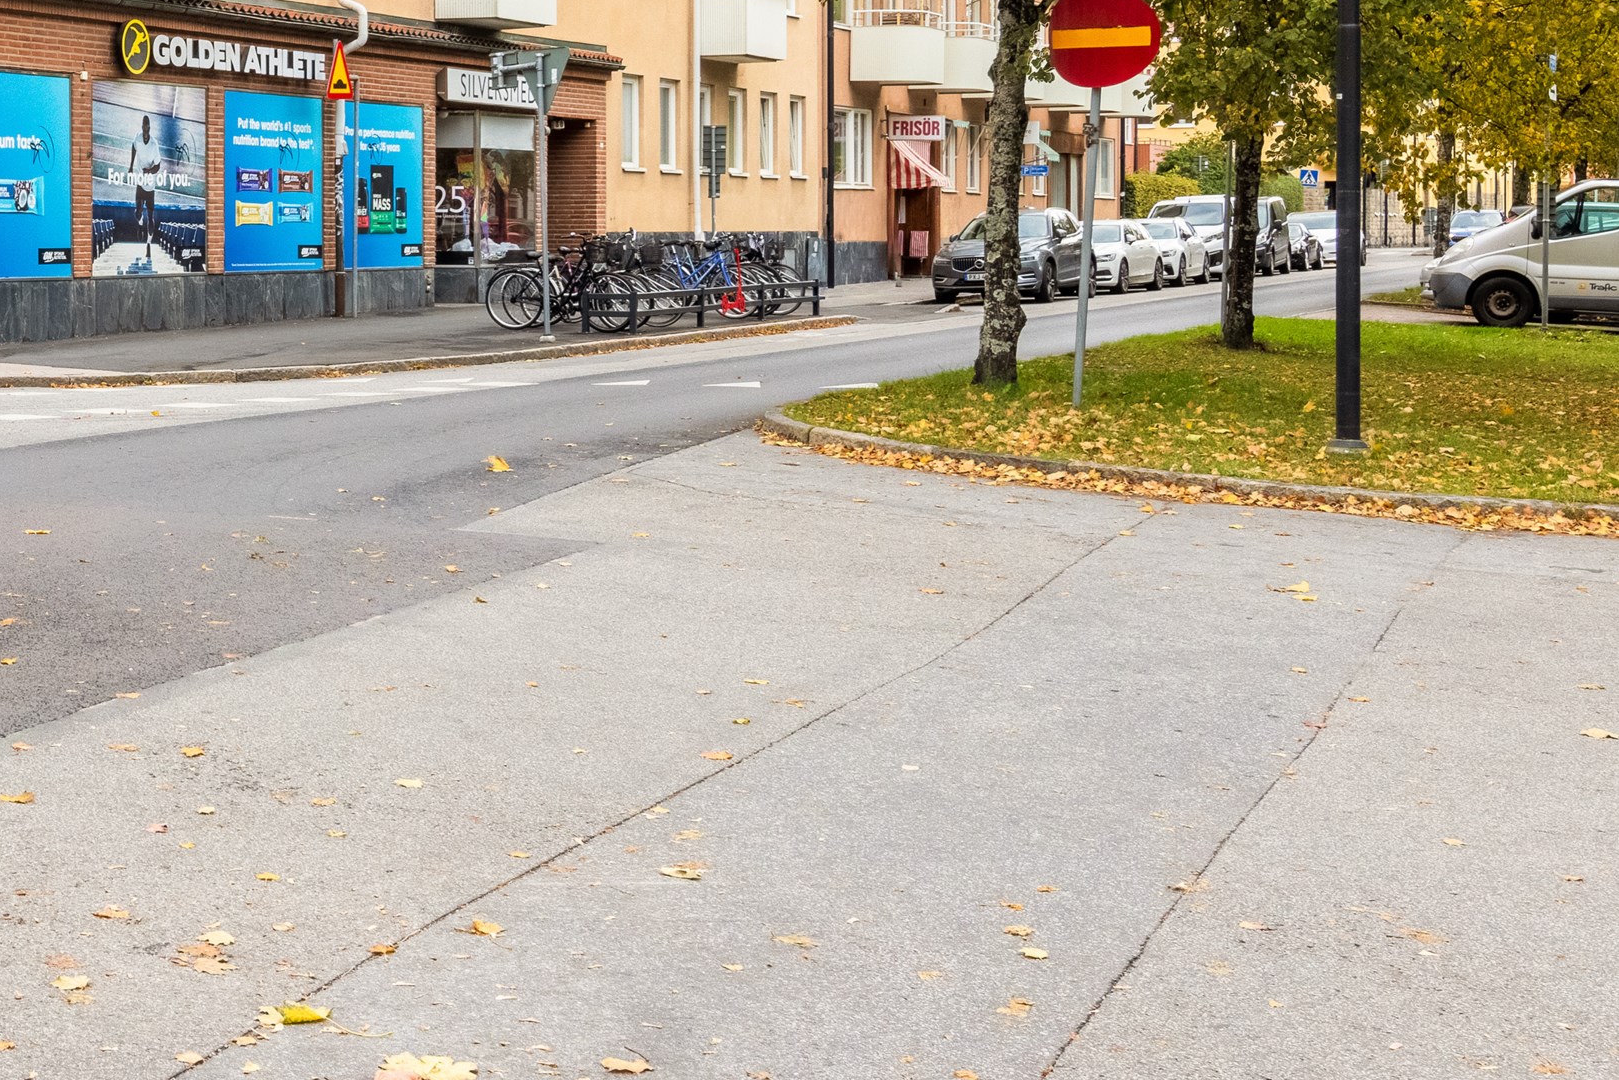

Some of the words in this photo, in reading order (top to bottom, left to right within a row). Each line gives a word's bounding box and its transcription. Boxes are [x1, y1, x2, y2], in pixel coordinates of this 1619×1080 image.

[152, 34, 241, 73] GOLDEN
[244, 45, 326, 81] ATHLETE
[249, 118, 260, 130] the
[892, 117, 940, 137] FRISÖR
[16, 134, 43, 150] taste
[108, 168, 124, 185] For
[127, 172, 154, 186] more
[156, 170, 167, 187] of
[169, 173, 191, 190] you.
[372, 198, 391, 211] MASS
[435, 185, 466, 214] 25
[1589, 283, 1618, 291] Trafic
